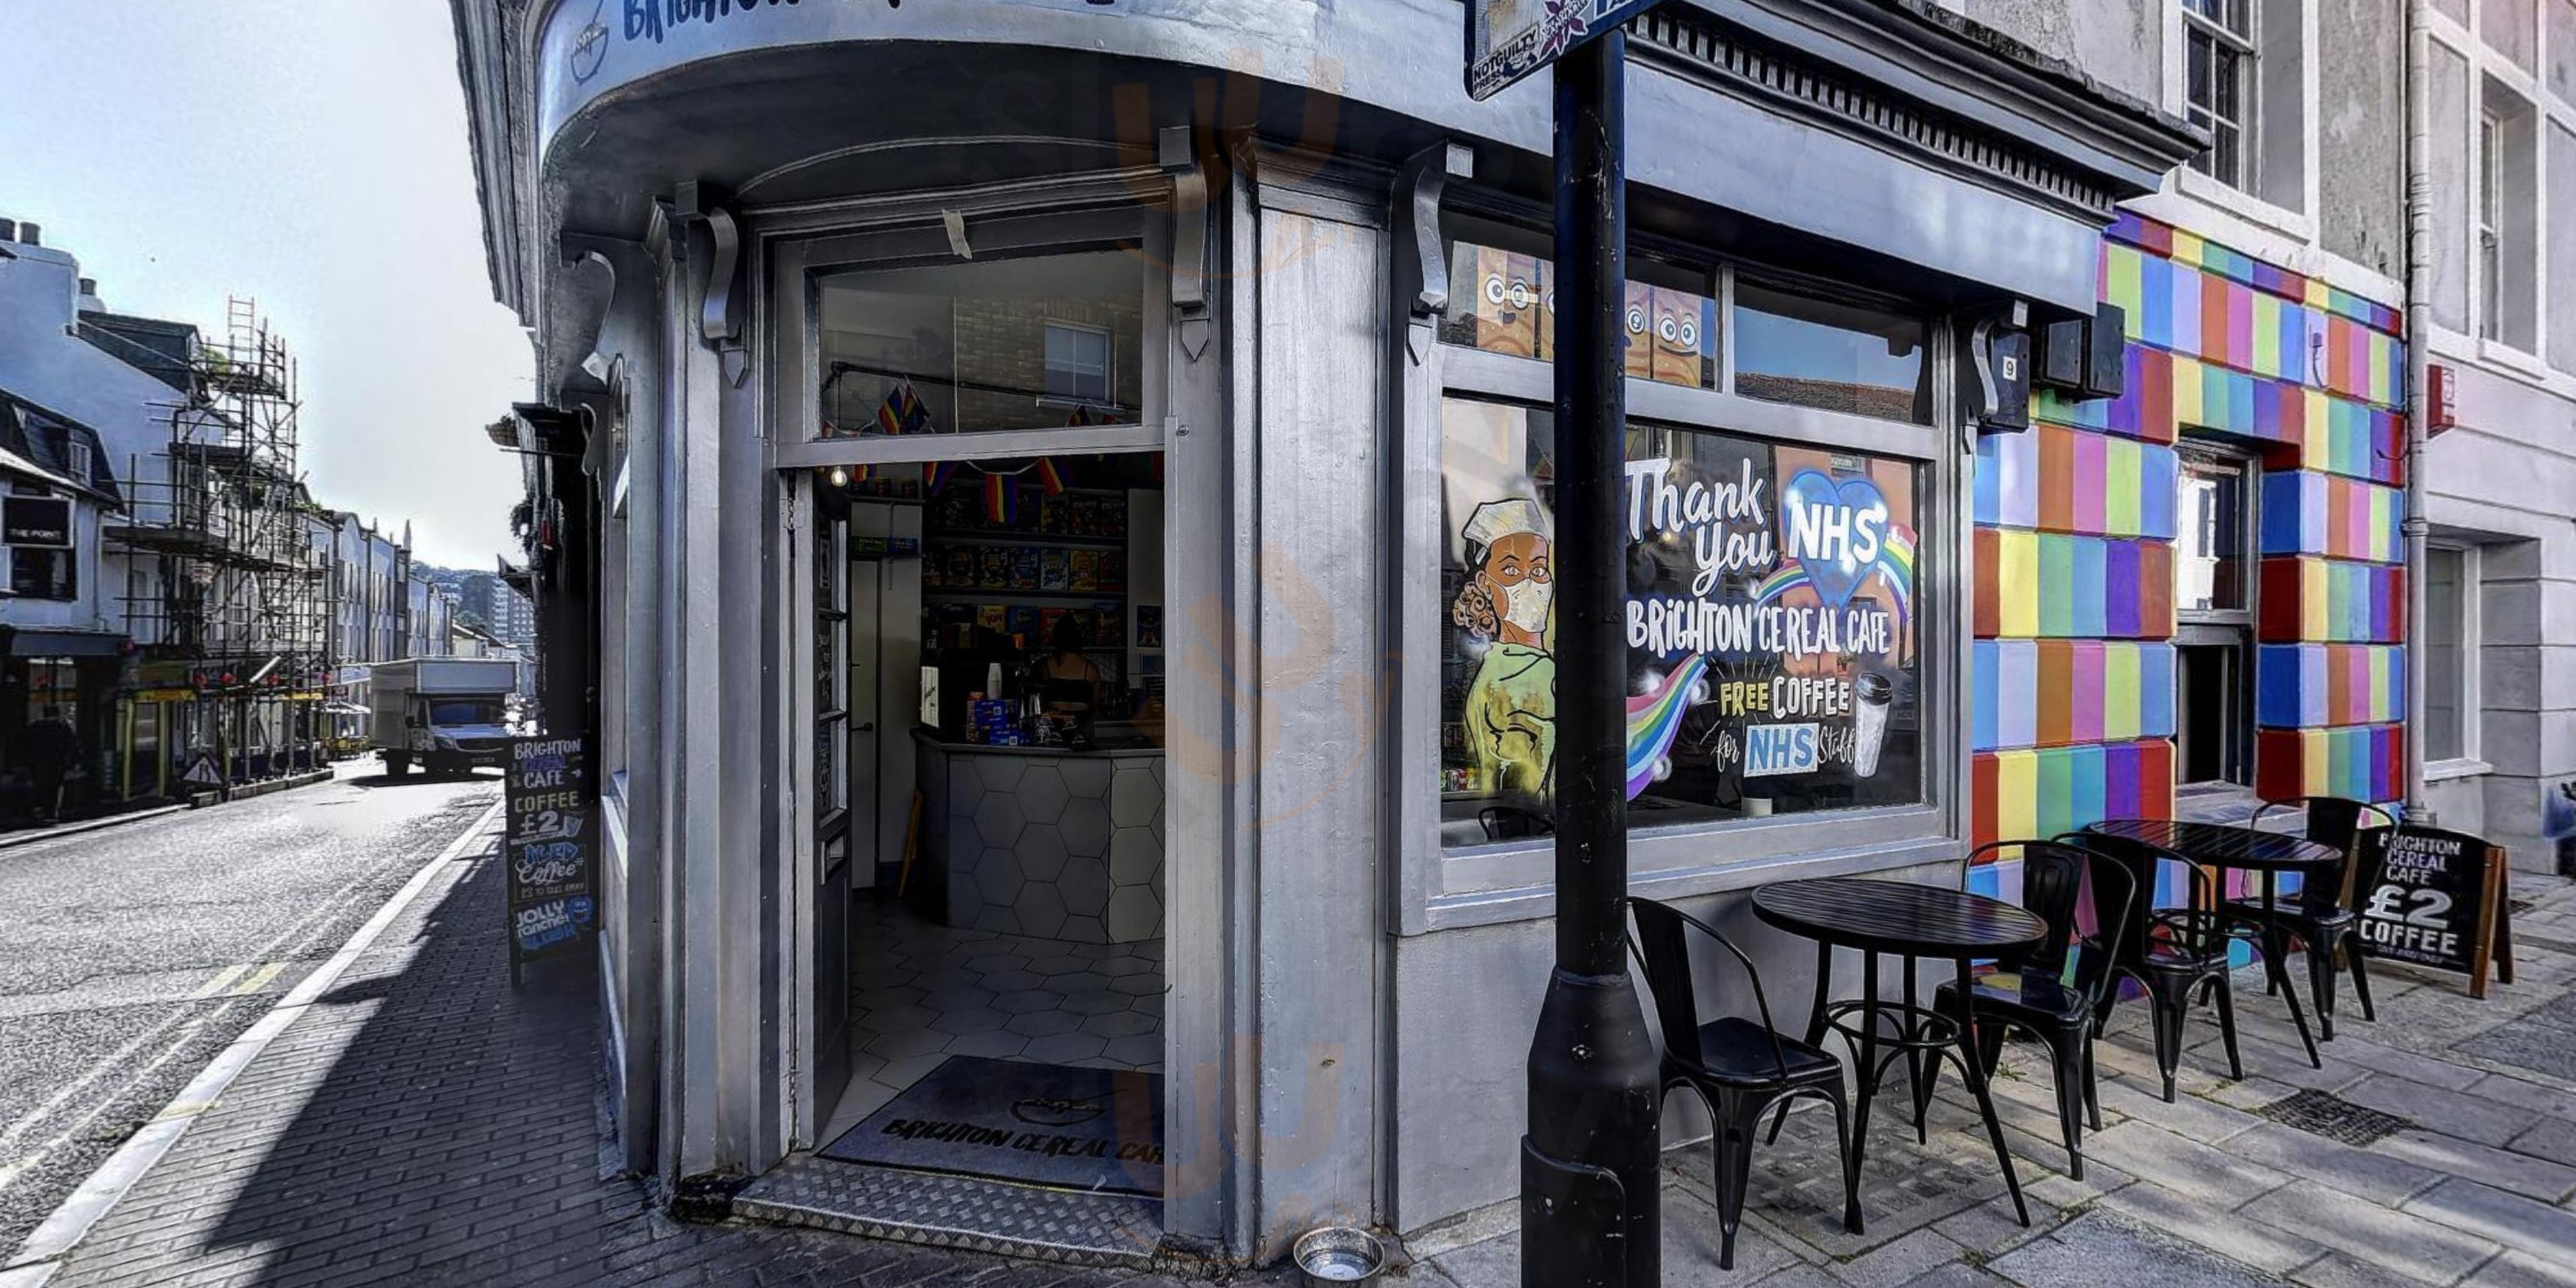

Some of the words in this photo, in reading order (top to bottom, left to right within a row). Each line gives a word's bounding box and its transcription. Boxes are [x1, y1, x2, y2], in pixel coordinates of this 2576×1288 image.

[2006, 361, 2013, 376] 9
[1625, 458, 1766, 542] Thank
[1789, 502, 1887, 563] NHS
[1759, 605, 1840, 660] CEREAL
[1847, 609, 1890, 654] CAFE
[1720, 680, 1770, 718] FREE
[1772, 675, 1850, 720] COFFEE
[514, 738, 581, 759] BRIGHTON
[1716, 729, 1740, 773] for
[1749, 728, 1813, 770] NHS
[524, 770, 565, 788] CAFE
[515, 791, 580, 813] COFFEE
[520, 810, 559, 835] £2
[516, 860, 576, 885] Coffee
[2387, 848, 2448, 872] CEREAL
[2387, 866, 2433, 885] CAFE
[516, 899, 564, 928] JOLLY
[2363, 884, 2453, 929] £2
[2360, 919, 2458, 956] COFFEE
[881, 1119, 1015, 1147] BRIGHTON
[1012, 1133, 1109, 1158] CEREAL
